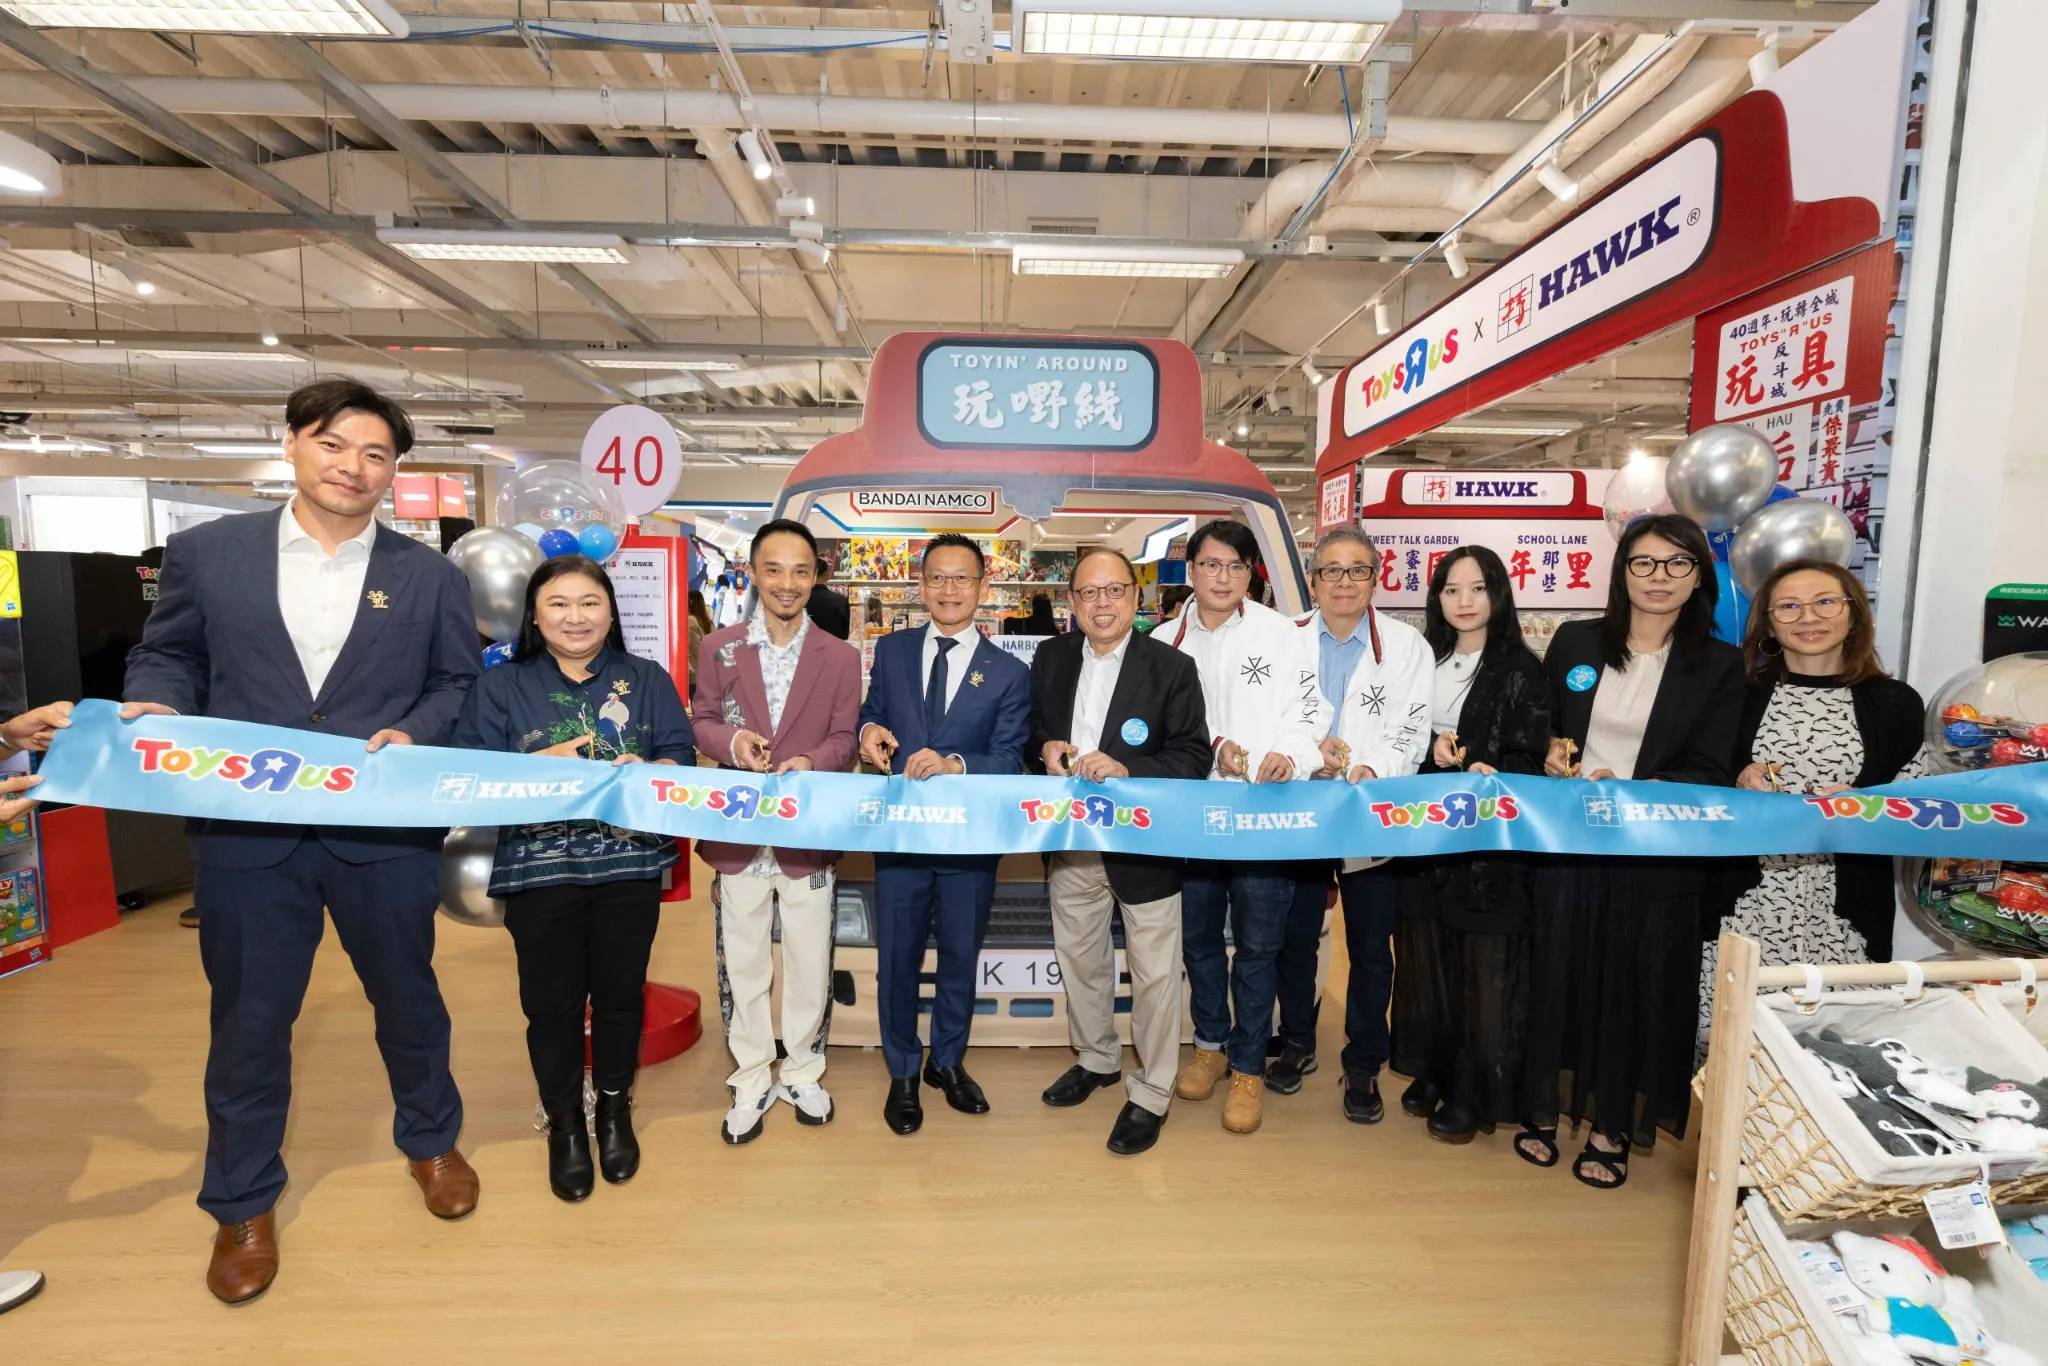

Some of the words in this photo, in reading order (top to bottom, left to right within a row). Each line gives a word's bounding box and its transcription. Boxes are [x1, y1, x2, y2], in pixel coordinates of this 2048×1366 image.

[1538, 195, 1681, 309] HAWK
[1037, 356, 1129, 373] AROUND
[1725, 355, 1764, 406] 玩
[1769, 342, 1790, 398] 反斗城
[1792, 330, 1835, 391] 具
[1767, 413, 1793, 430] HAU
[596, 436, 663, 487] 40
[1455, 481, 1538, 497] HAWK
[858, 491, 922, 507] BANDAI
[925, 492, 987, 508] NAMCO
[1400, 535, 1421, 544] TALK
[1424, 535, 1459, 544] GARDEN
[1517, 535, 1558, 544] SCHOOL
[1562, 535, 1587, 544] LANE
[1509, 549, 1536, 591] 年
[1542, 550, 1560, 592] 那些
[1566, 551, 1592, 589] 里
[478, 780, 583, 799] HAWK
[887, 805, 967, 824] HAWK
[1235, 811, 1317, 831] HAWK
[1623, 803, 1735, 822] HAWK
[983, 962, 1004, 985] K
[1026, 962, 1063, 985] 19
